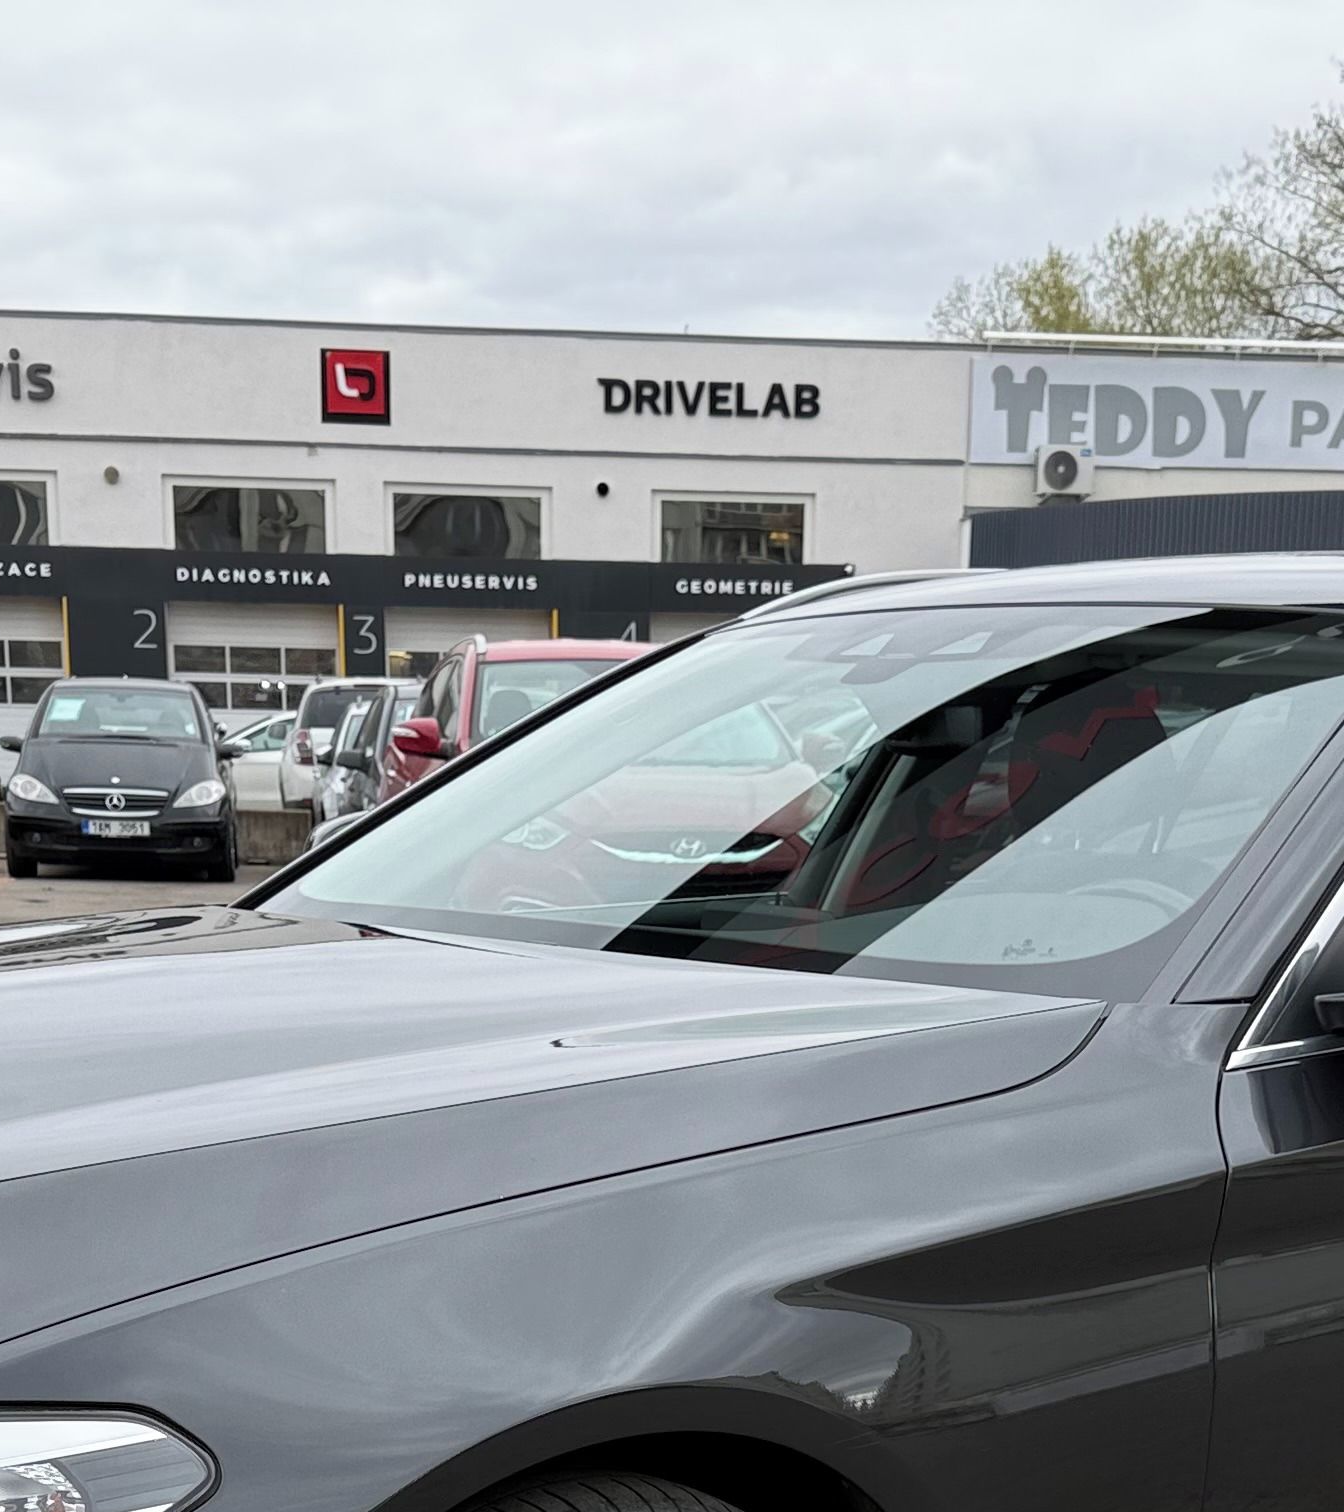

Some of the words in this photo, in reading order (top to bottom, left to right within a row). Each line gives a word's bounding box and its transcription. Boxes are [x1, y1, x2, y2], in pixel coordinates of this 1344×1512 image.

[597, 378, 820, 419] DRIVELAB
[992, 365, 1266, 459] TEDDY
[176, 567, 331, 586] DIAGNOSTIKA
[404, 573, 538, 590] PNEUSERVIS
[675, 579, 794, 595] GEOMETRIE
[133, 609, 158, 649] 2
[353, 615, 378, 654] 3
